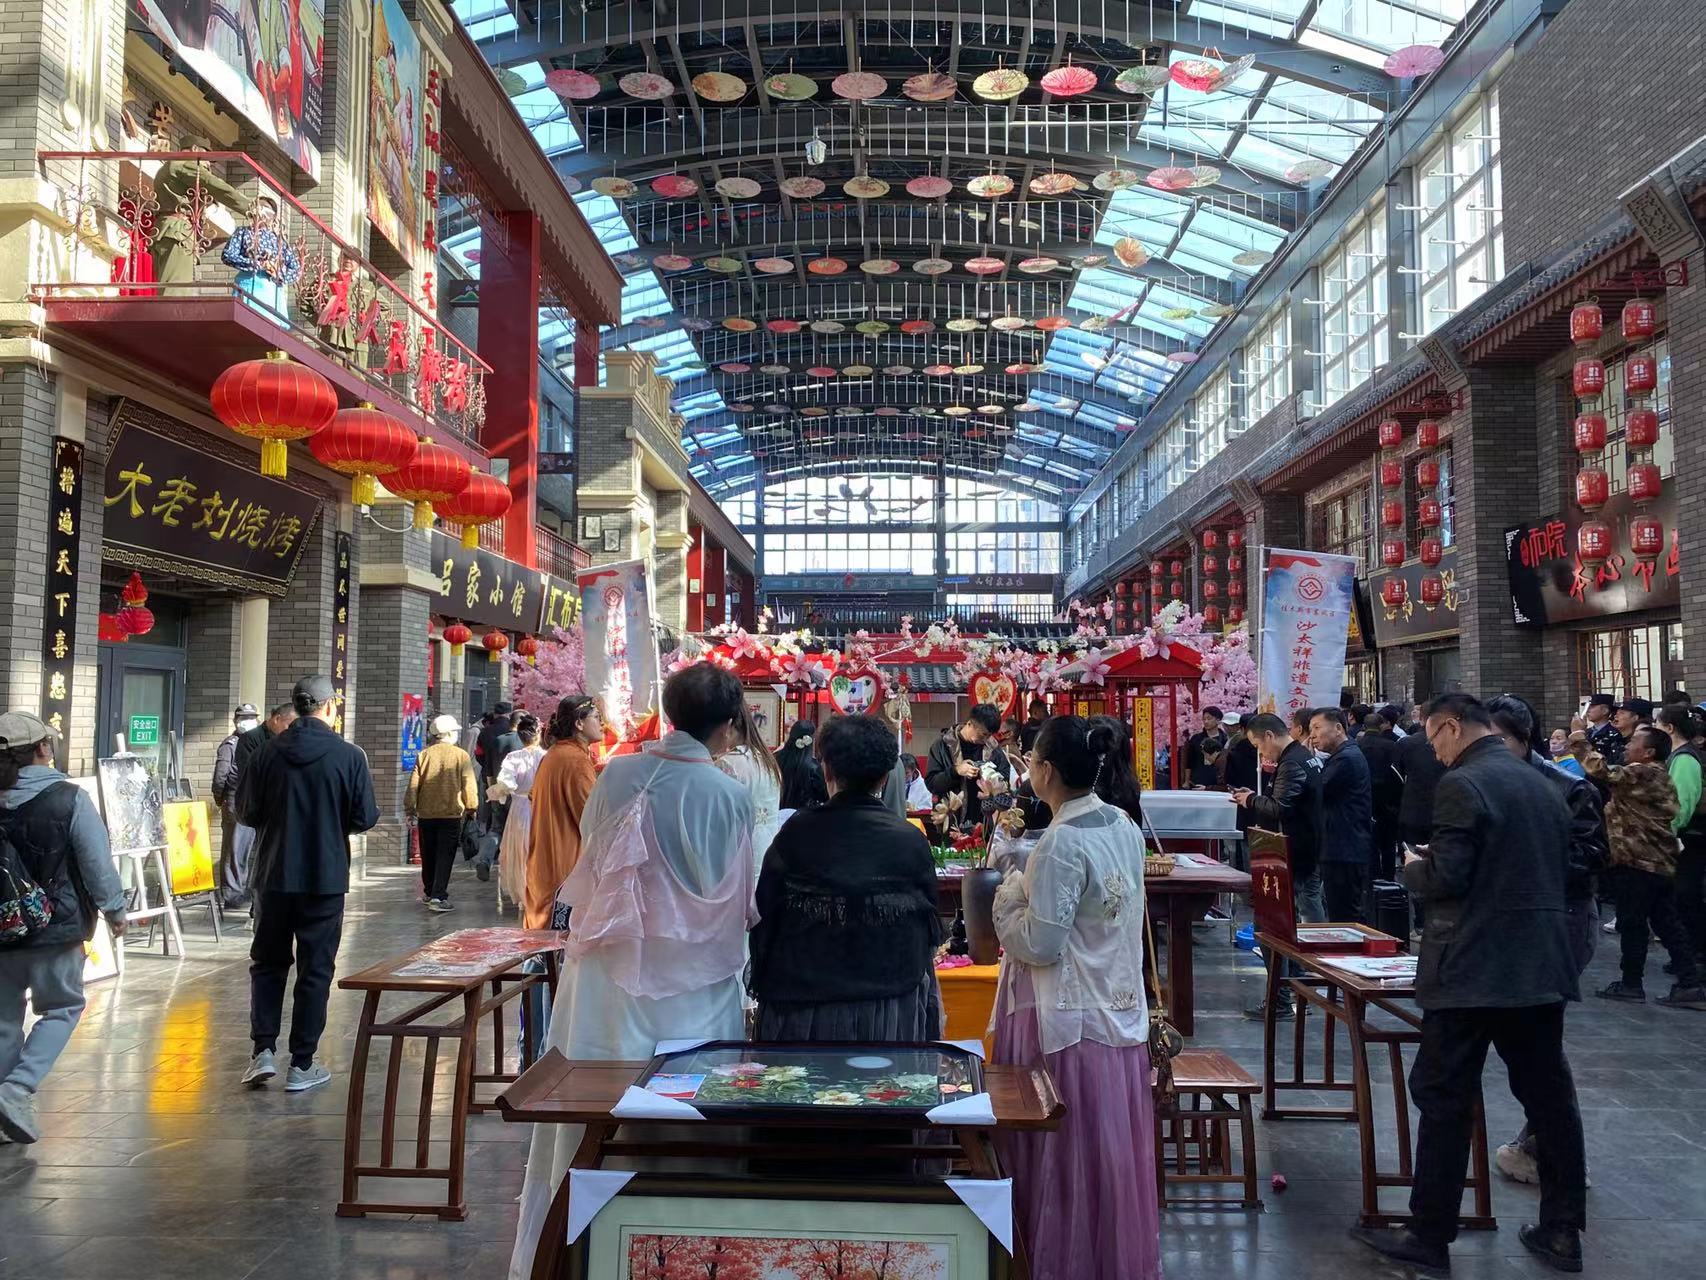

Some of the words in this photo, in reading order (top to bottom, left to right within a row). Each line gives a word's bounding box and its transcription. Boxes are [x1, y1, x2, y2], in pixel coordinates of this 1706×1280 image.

[104, 462, 301, 558] 大老刘烧烤
[440, 558, 526, 618] 吕家小馆
[133, 719, 157, 730] 安全出口
[136, 731, 152, 741] EXIT
